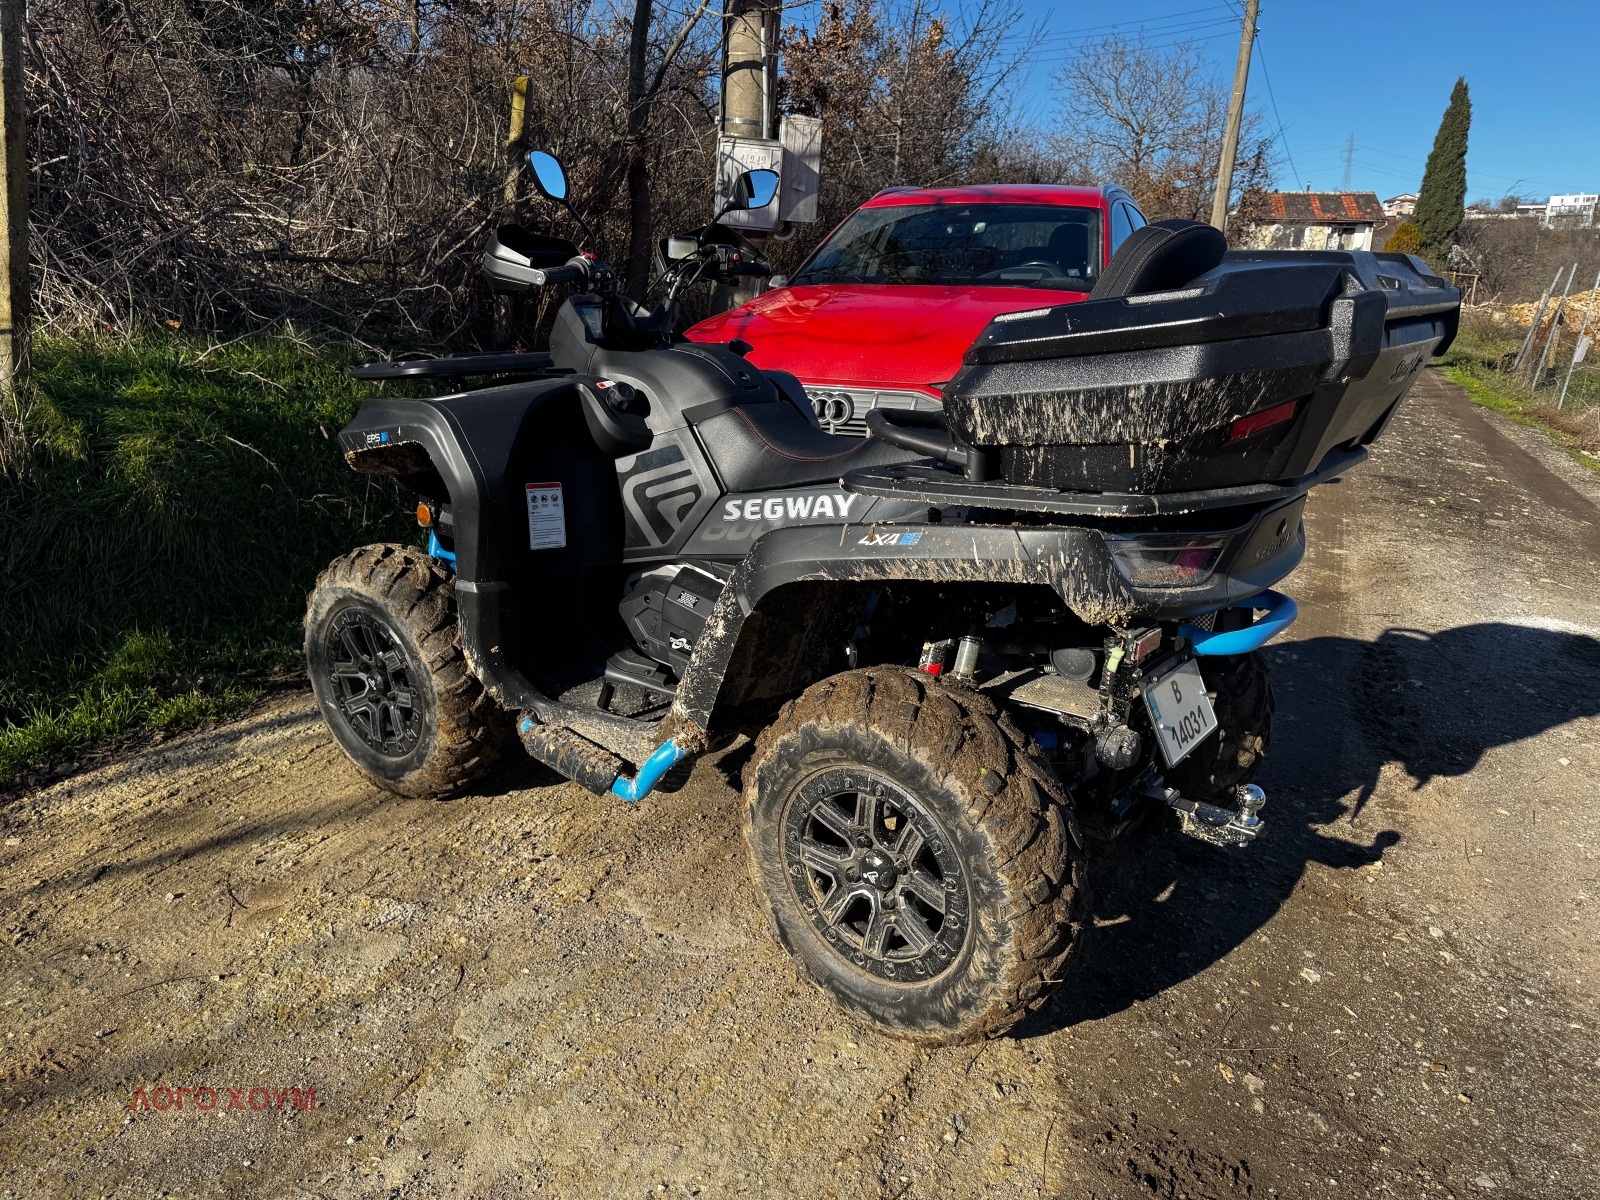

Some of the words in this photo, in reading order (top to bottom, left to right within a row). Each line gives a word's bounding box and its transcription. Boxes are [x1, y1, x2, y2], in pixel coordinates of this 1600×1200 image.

[366, 433, 381, 443] EPS
[723, 494, 858, 522] SEGWAY
[1170, 680, 1183, 704] B
[1171, 705, 1208, 750] 14031
